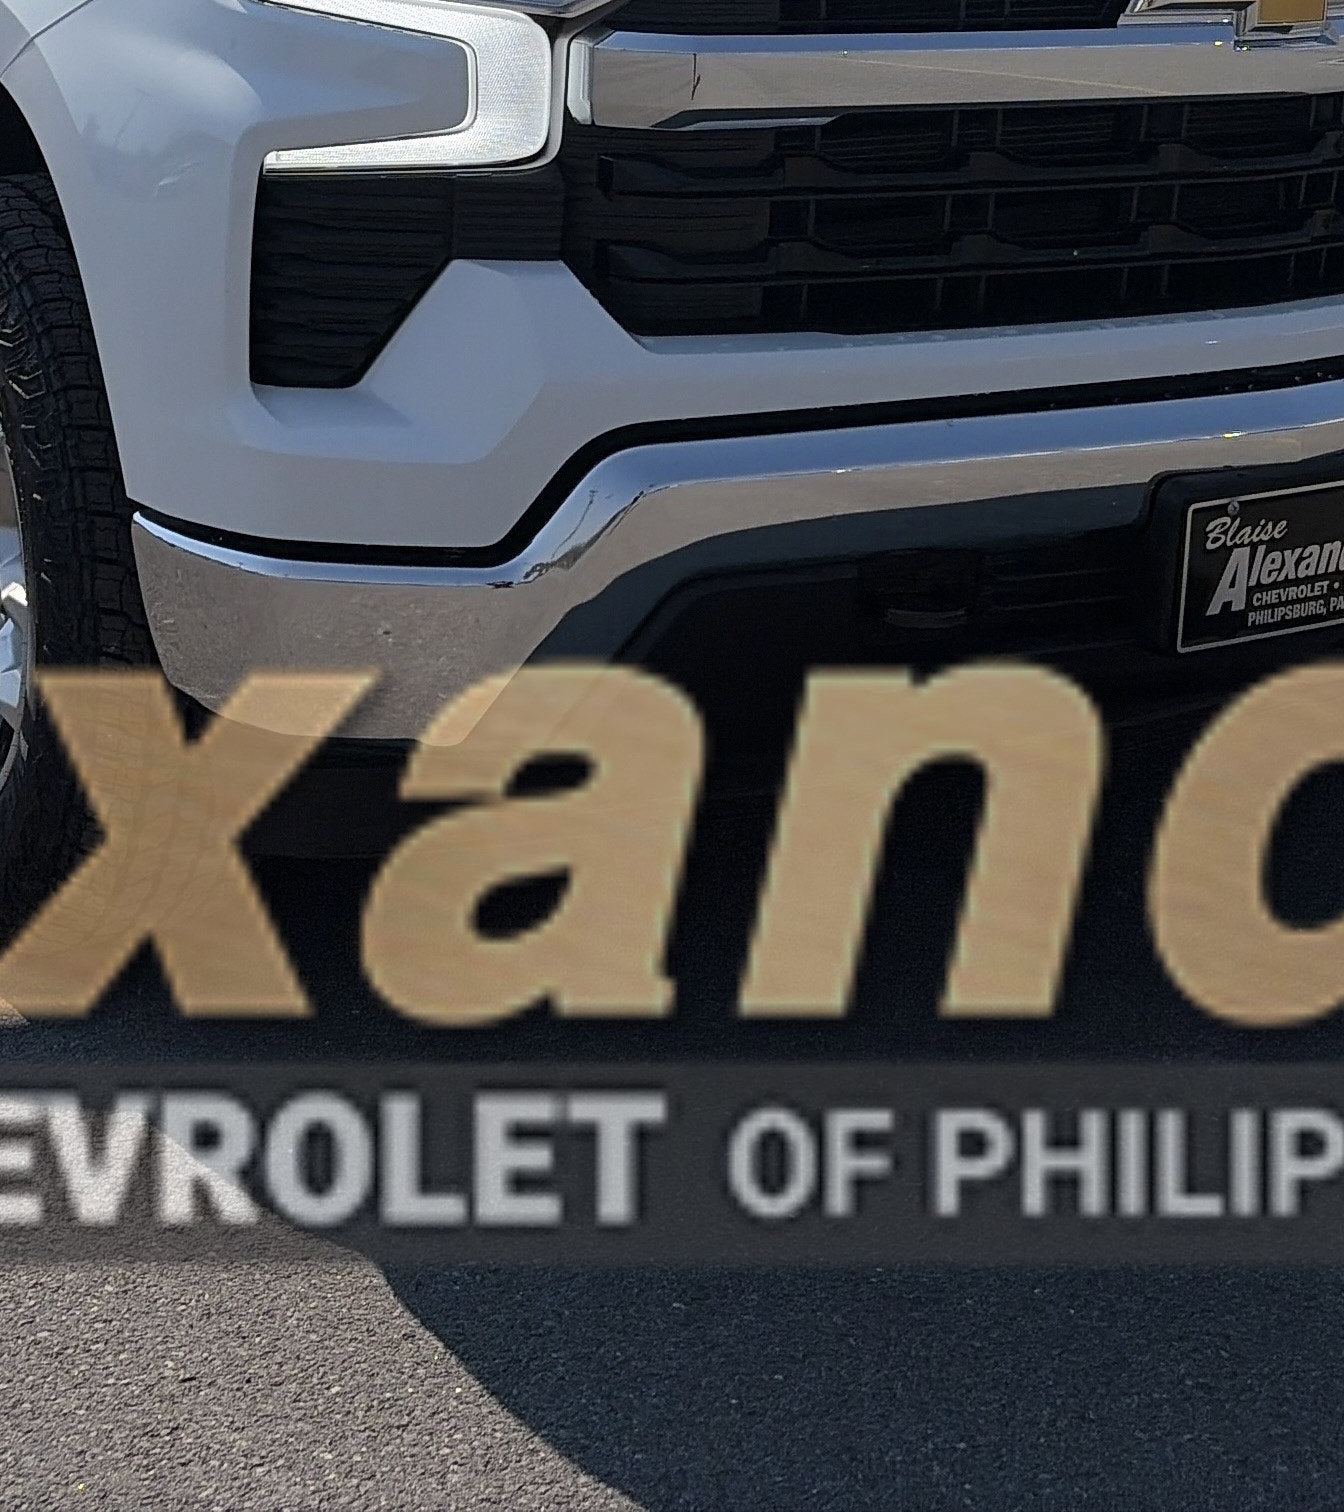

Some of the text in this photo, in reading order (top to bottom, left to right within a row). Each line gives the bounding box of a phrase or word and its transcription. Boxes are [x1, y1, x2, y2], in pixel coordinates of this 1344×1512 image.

[1206, 516, 1288, 550] Blaise
[1252, 580, 1329, 607] CHEVROLET
[1247, 599, 1327, 627] PHILIPSBURG,
